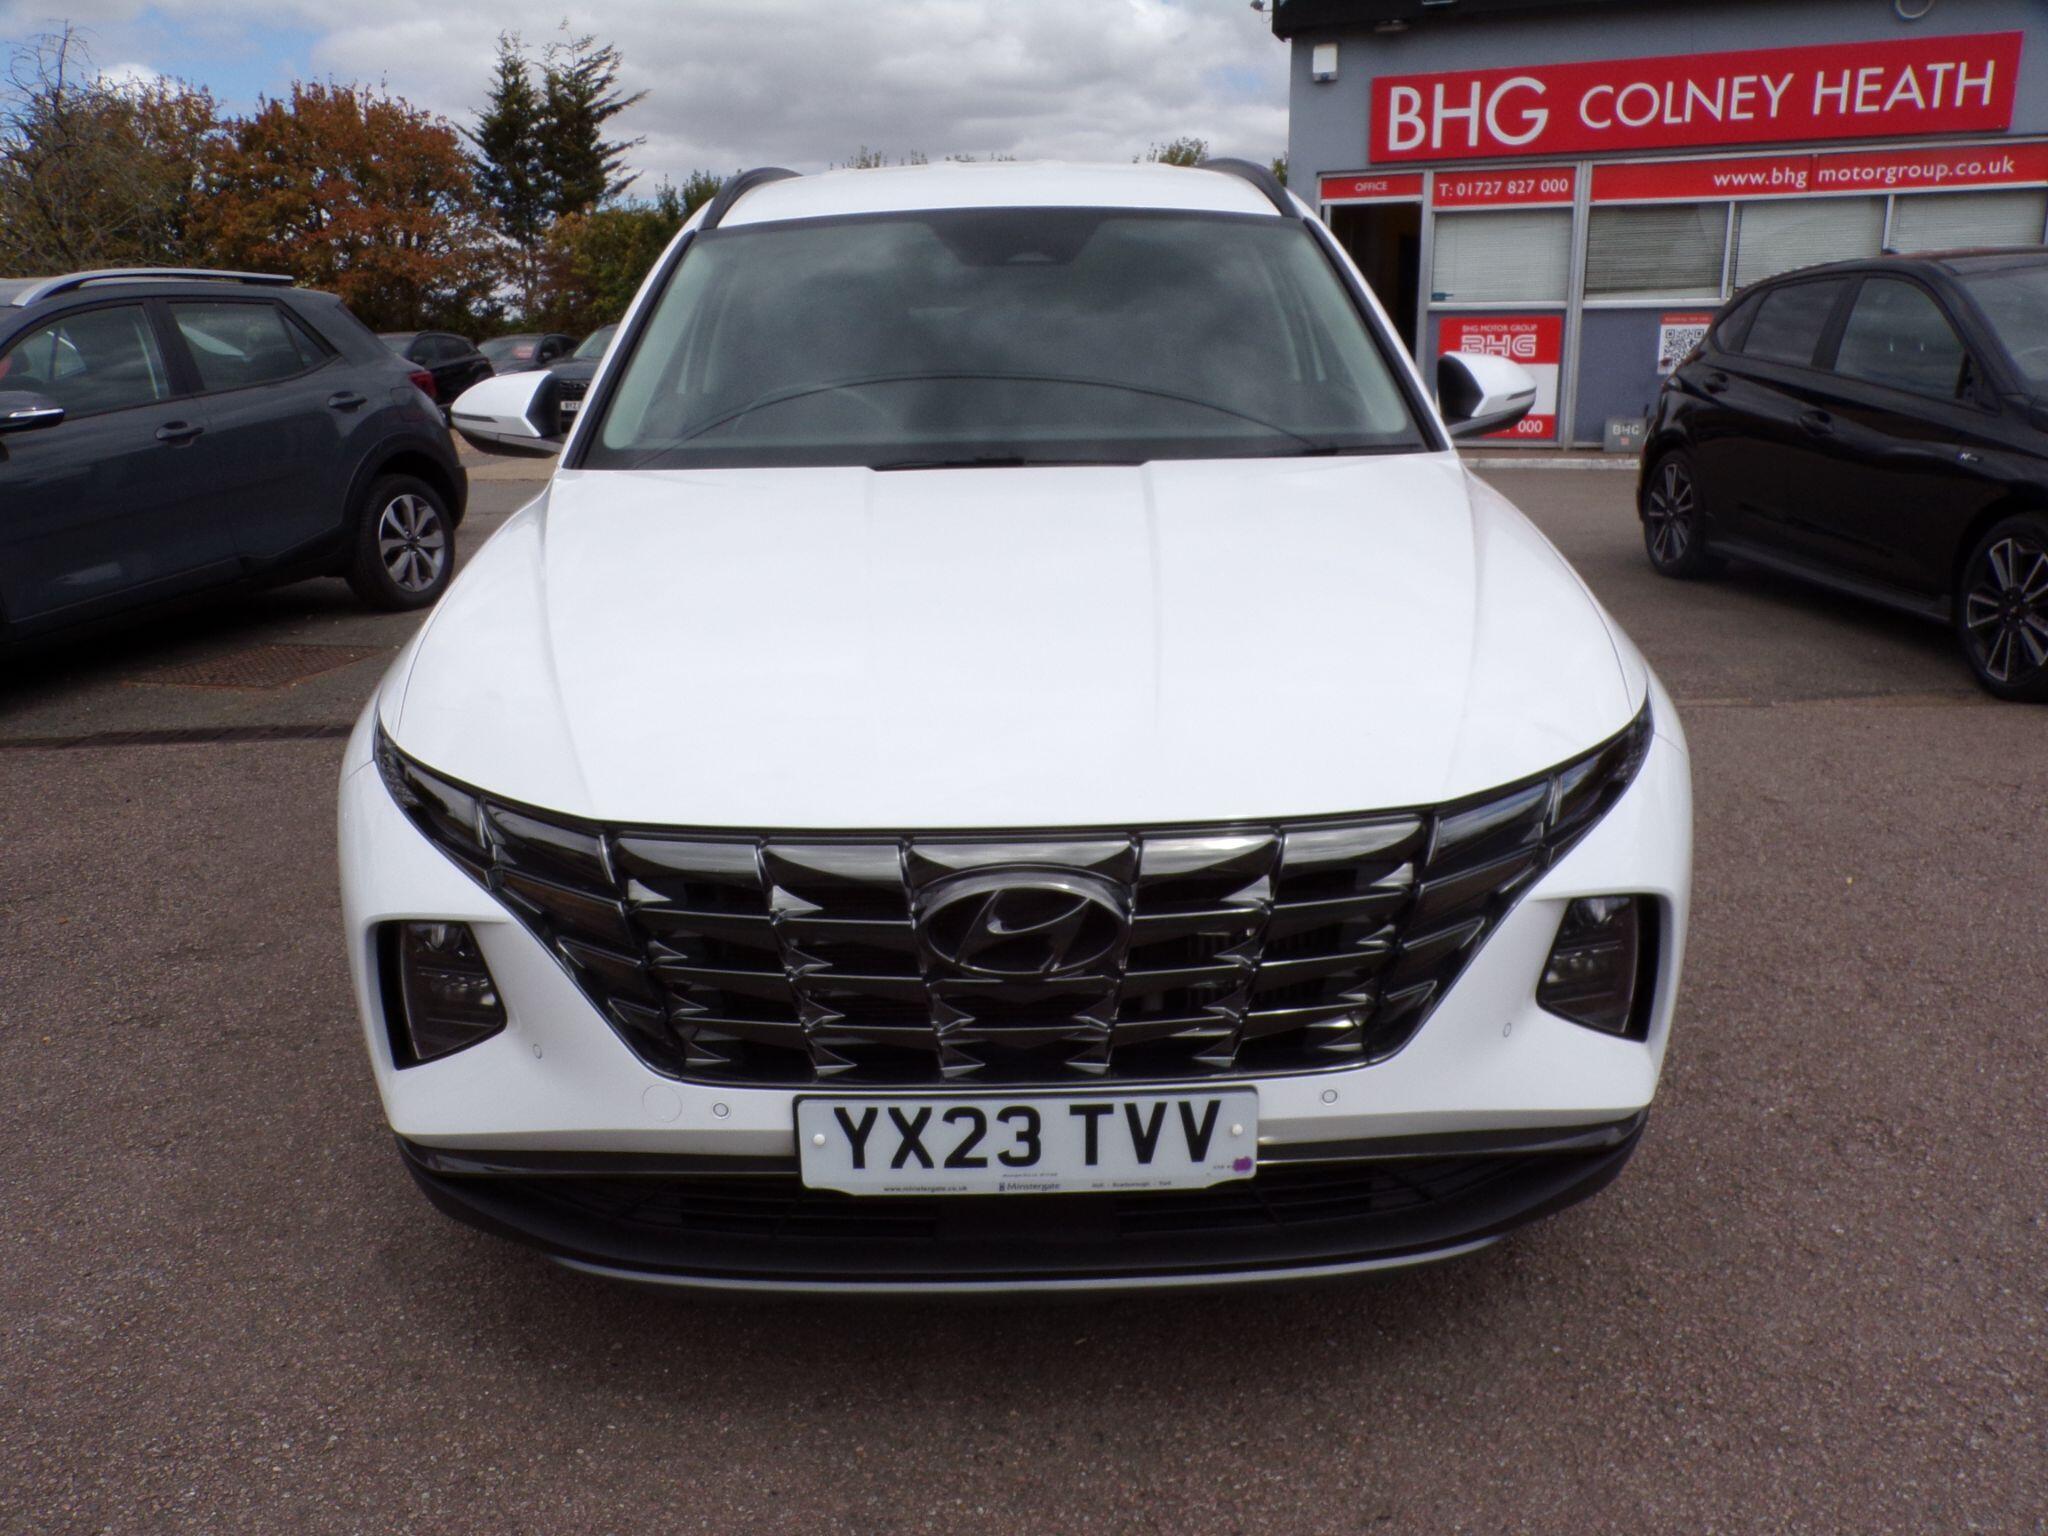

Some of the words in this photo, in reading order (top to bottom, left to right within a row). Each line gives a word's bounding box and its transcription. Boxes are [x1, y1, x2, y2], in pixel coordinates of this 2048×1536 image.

[1387, 76, 1549, 151] BHG
[1578, 73, 1795, 130] COLNEY
[1812, 59, 1996, 117] HEATH
[1818, 156, 2015, 184] motorgroup.co.uk
[1354, 181, 1389, 193] OFFICE
[1439, 183, 1453, 197] T:
[1456, 181, 1503, 197] 01727
[1507, 180, 1535, 195] 827
[1540, 178, 1569, 193] 000
[1462, 325, 1479, 333] BHG
[1480, 324, 1509, 332] MOTOR
[1461, 334, 1537, 357] BHG
[1517, 420, 1543, 433] 000
[1612, 424, 1639, 435] BHG
[833, 1105, 1042, 1170] YX23
[1069, 1100, 1222, 1166] TVV
[1006, 1182, 1061, 1192] Minstergate
